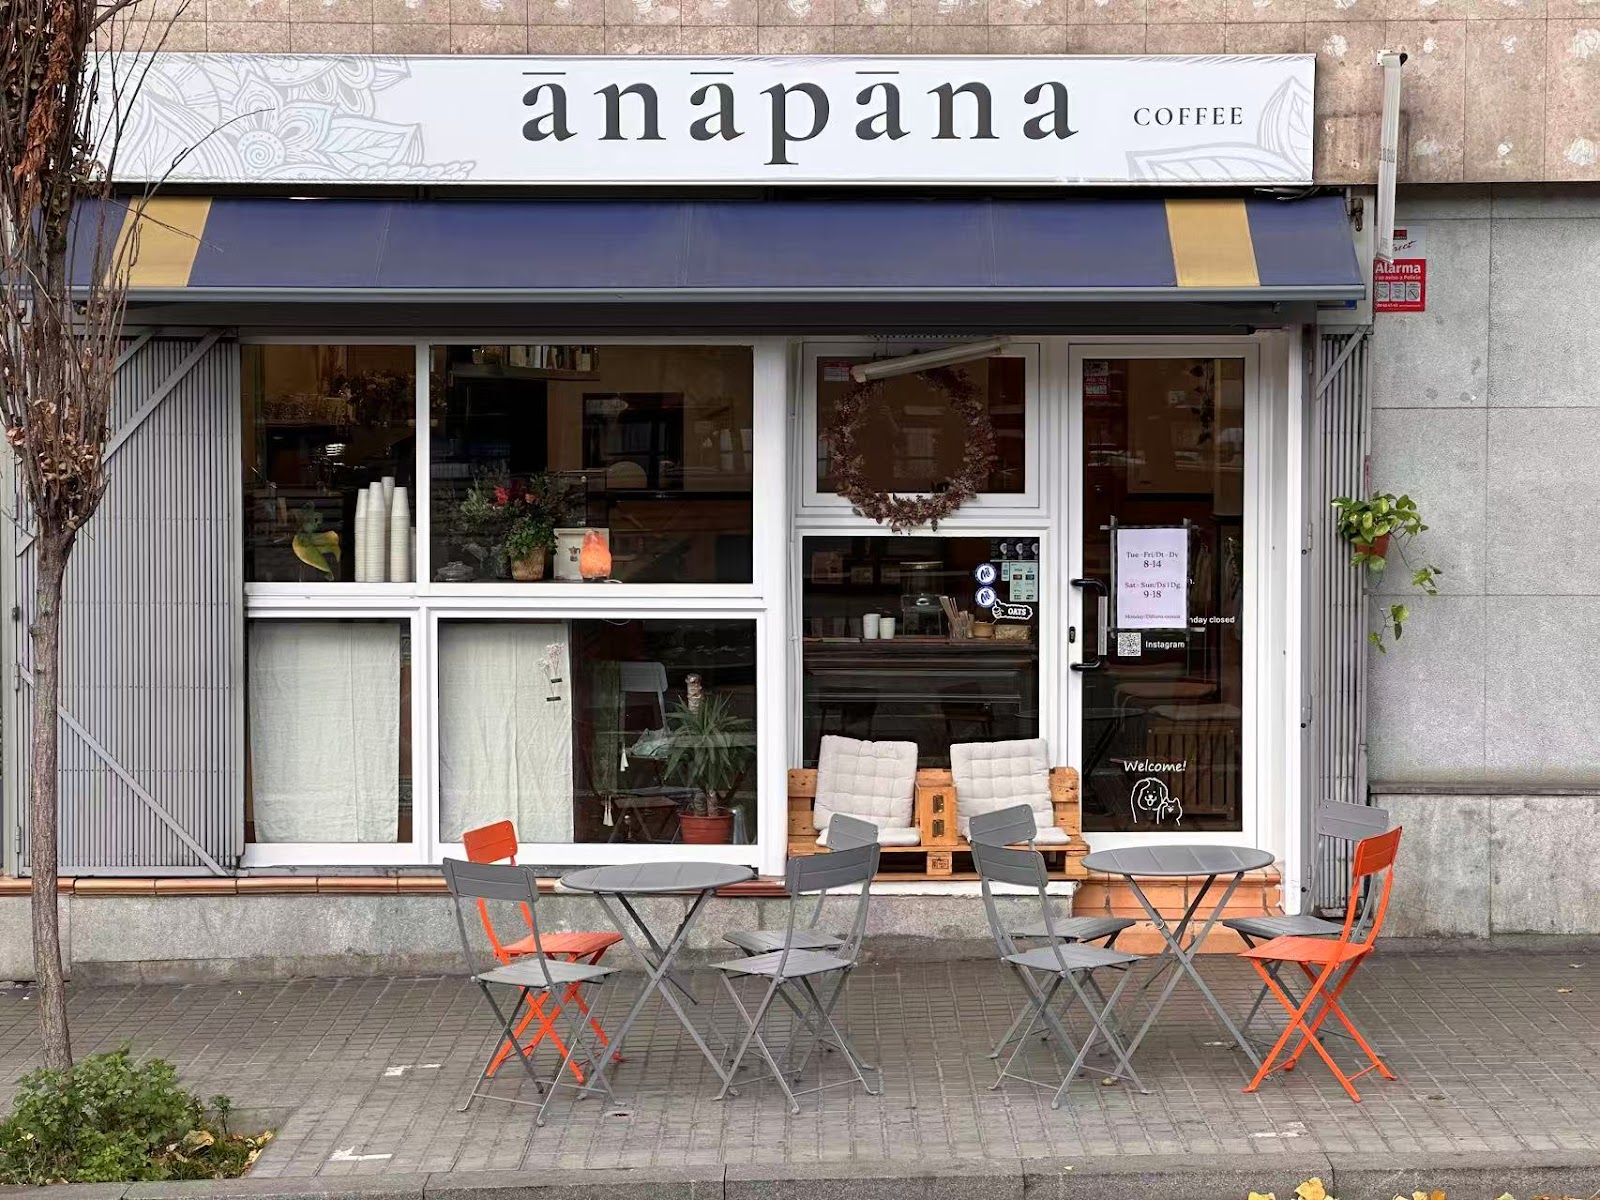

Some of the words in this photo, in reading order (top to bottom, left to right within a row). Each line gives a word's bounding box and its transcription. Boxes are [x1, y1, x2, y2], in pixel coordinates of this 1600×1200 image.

[1133, 106, 1243, 126] COFFEE
[1375, 263, 1421, 273] Alarma
[1143, 560, 1162, 569] 8-14
[1124, 581, 1136, 589] Sat
[1143, 590, 1162, 599] 9-18
[1208, 615, 1236, 624] closed
[1145, 639, 1186, 650] Instagram
[1123, 758, 1187, 772] Welcome!
